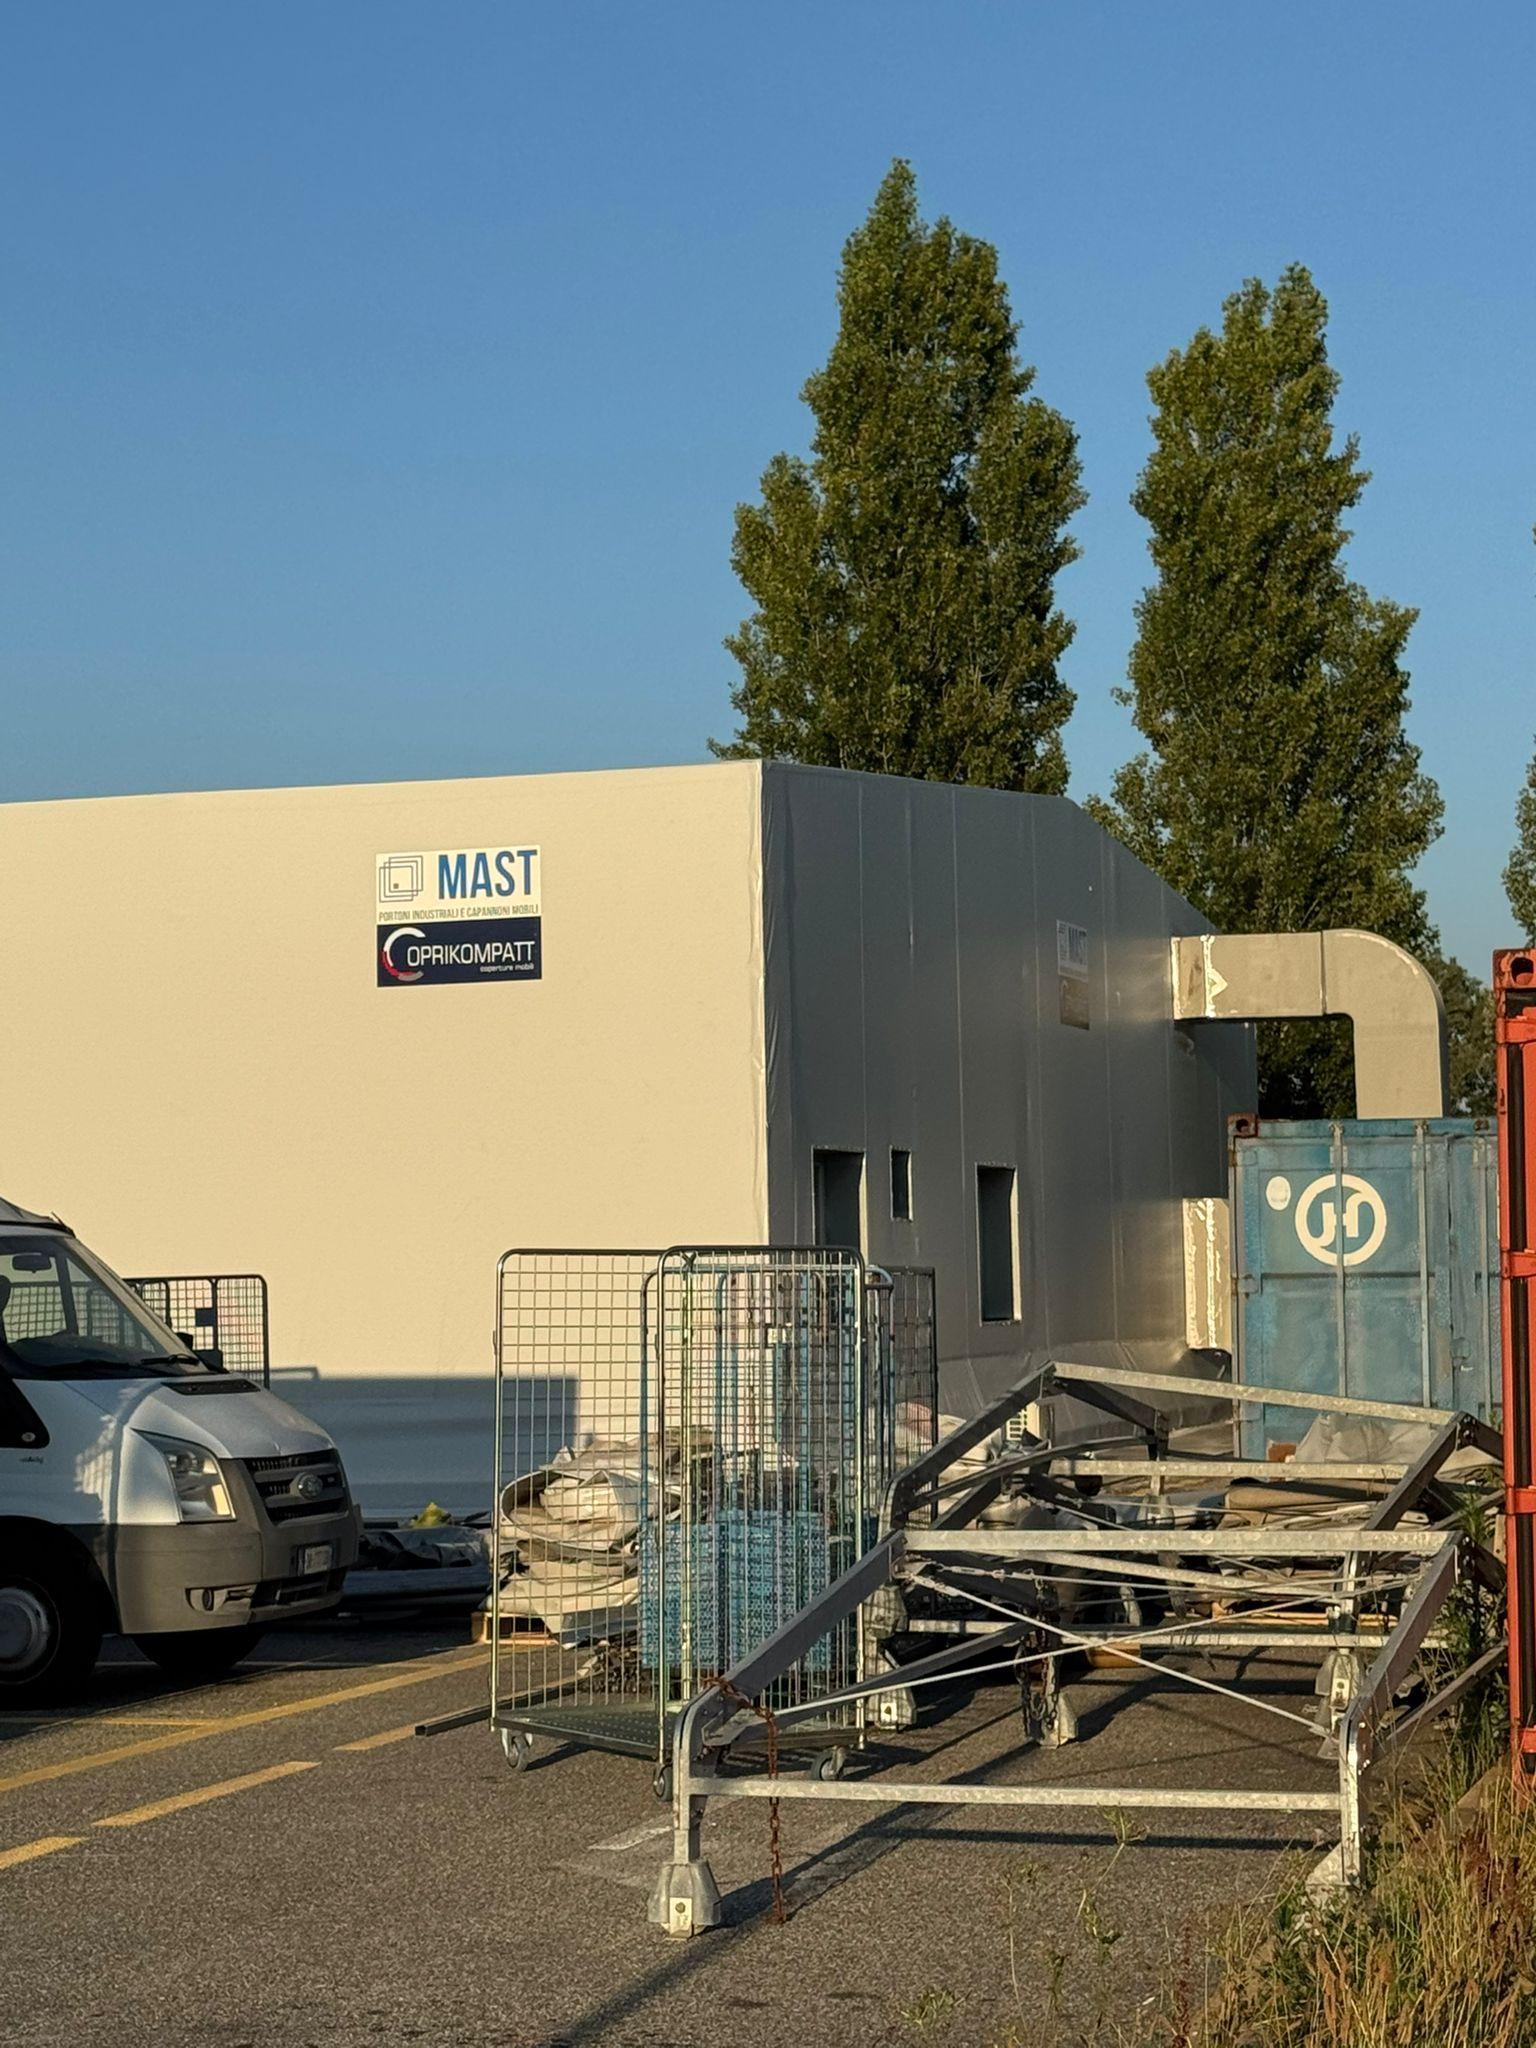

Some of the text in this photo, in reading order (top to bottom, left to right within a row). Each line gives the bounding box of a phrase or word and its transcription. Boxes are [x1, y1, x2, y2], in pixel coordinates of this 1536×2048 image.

[438, 849, 538, 900] MAST
[378, 903, 539, 922] PORTONI INDUSTRIALI E CAPANNONI MOBILI
